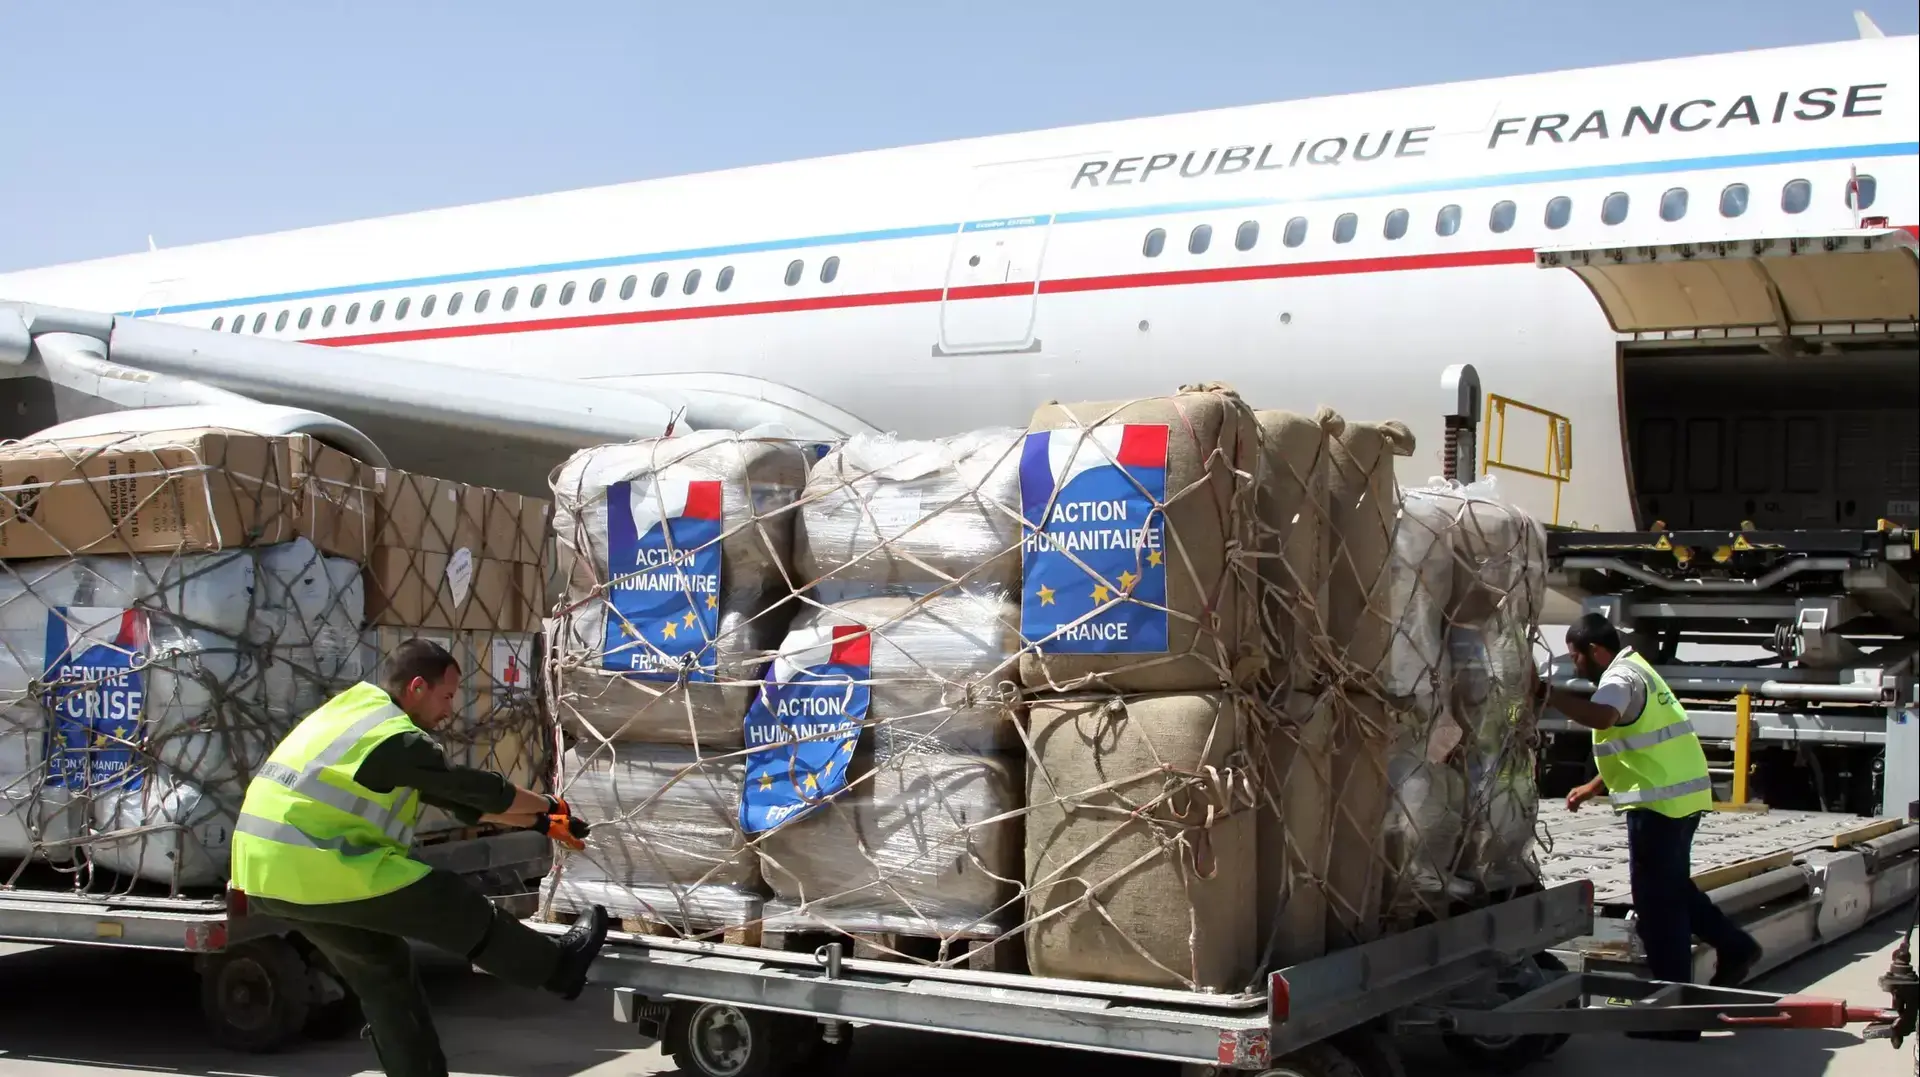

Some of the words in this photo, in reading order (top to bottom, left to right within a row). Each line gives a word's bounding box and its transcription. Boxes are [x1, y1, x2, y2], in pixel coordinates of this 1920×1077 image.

[1070, 125, 1436, 189] REPUBLIQUE
[1487, 83, 1888, 149] FRANCAISE
[109, 459, 119, 516] COLLAPSBLE
[1051, 500, 1127, 523] ACTION
[1027, 528, 1160, 552] HUMANITAIRE
[636, 548, 695, 567] ACTION
[614, 573, 717, 592] HUMANITAIRE
[1056, 622, 1128, 641] FRANCE
[60, 665, 129, 687] CENTRE
[67, 689, 142, 720] CRISE
[777, 697, 840, 716] ACTION
[750, 721, 857, 743] HUMANITAIRE
[48, 758, 77, 769] CTON
[79, 758, 138, 772] MANITAI
[74, 772, 110, 783] FRNCE
